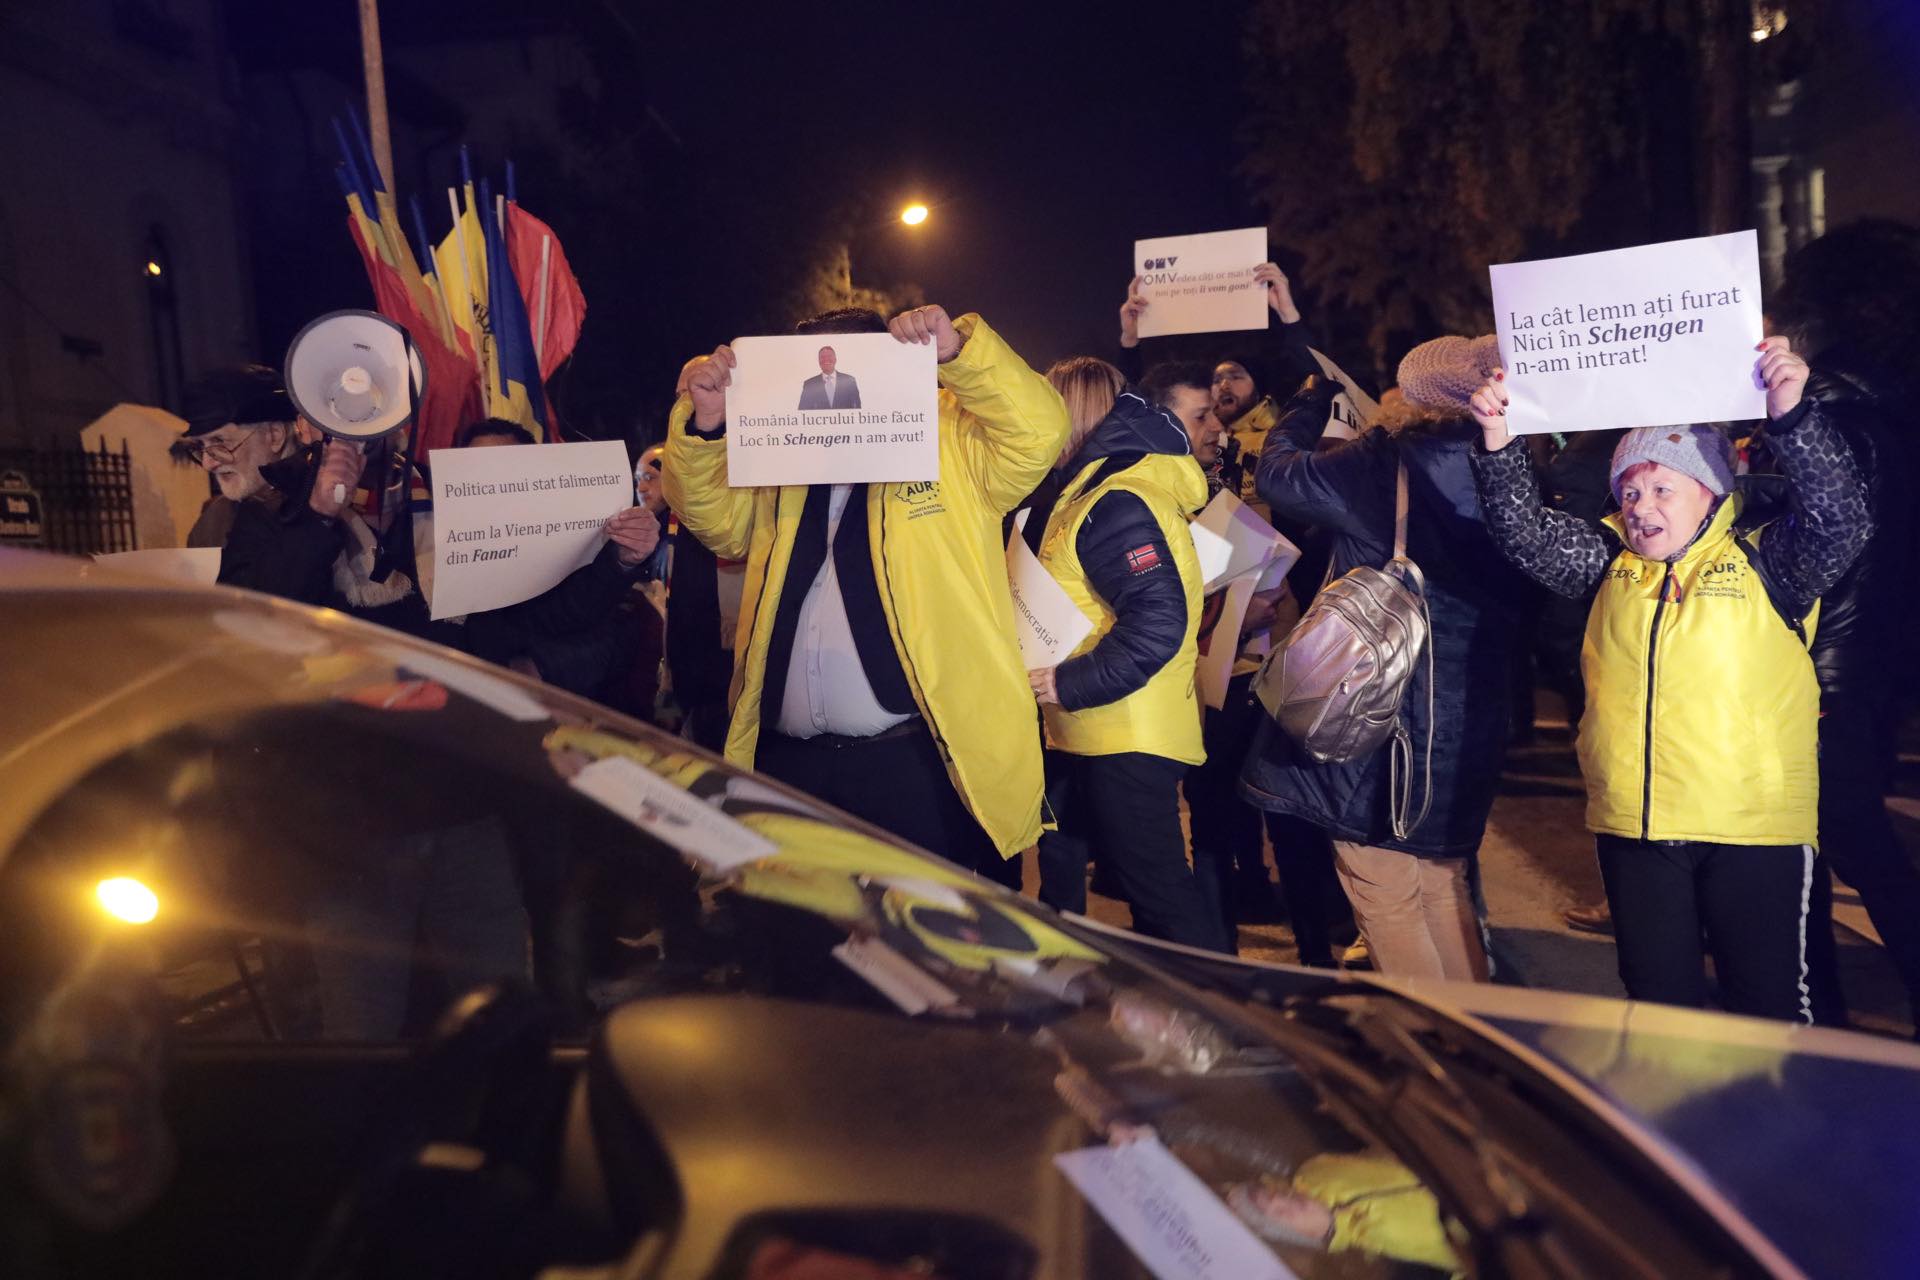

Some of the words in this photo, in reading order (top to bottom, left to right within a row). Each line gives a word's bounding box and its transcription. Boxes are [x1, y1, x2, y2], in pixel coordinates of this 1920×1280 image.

[1510, 311, 1535, 331] La
[1541, 306, 1574, 328] cât
[1580, 302, 1637, 324] lemn
[1644, 293, 1674, 320] ați
[1682, 286, 1742, 311] furat
[1513, 333, 1554, 353] Nici
[1559, 330, 1582, 348] în
[1588, 317, 1705, 345] Schengen
[1515, 355, 1571, 376] n-am
[1576, 344, 1648, 371] intrat!
[739, 413, 799, 427] România
[802, 412, 855, 426] lucrului
[858, 411, 889, 425] bine
[891, 410, 926, 424] făcut
[739, 433, 764, 447] Loc
[766, 433, 780, 446] în
[783, 432, 851, 448] Schengen
[855, 434, 864, 443] n
[866, 433, 888, 444] am
[890, 430, 925, 443] avut!
[445, 481, 496, 498] Politica
[499, 478, 530, 494] unui
[532, 475, 557, 491] stat
[559, 472, 621, 488] falimentar
[907, 481, 934, 497] AUR
[446, 528, 486, 544] Acum
[490, 524, 501, 539] la
[505, 519, 542, 537] Viena
[546, 522, 561, 536] pe
[446, 550, 469, 565] din
[472, 545, 518, 562] Fanar!
[1703, 562, 1737, 577] AUR
